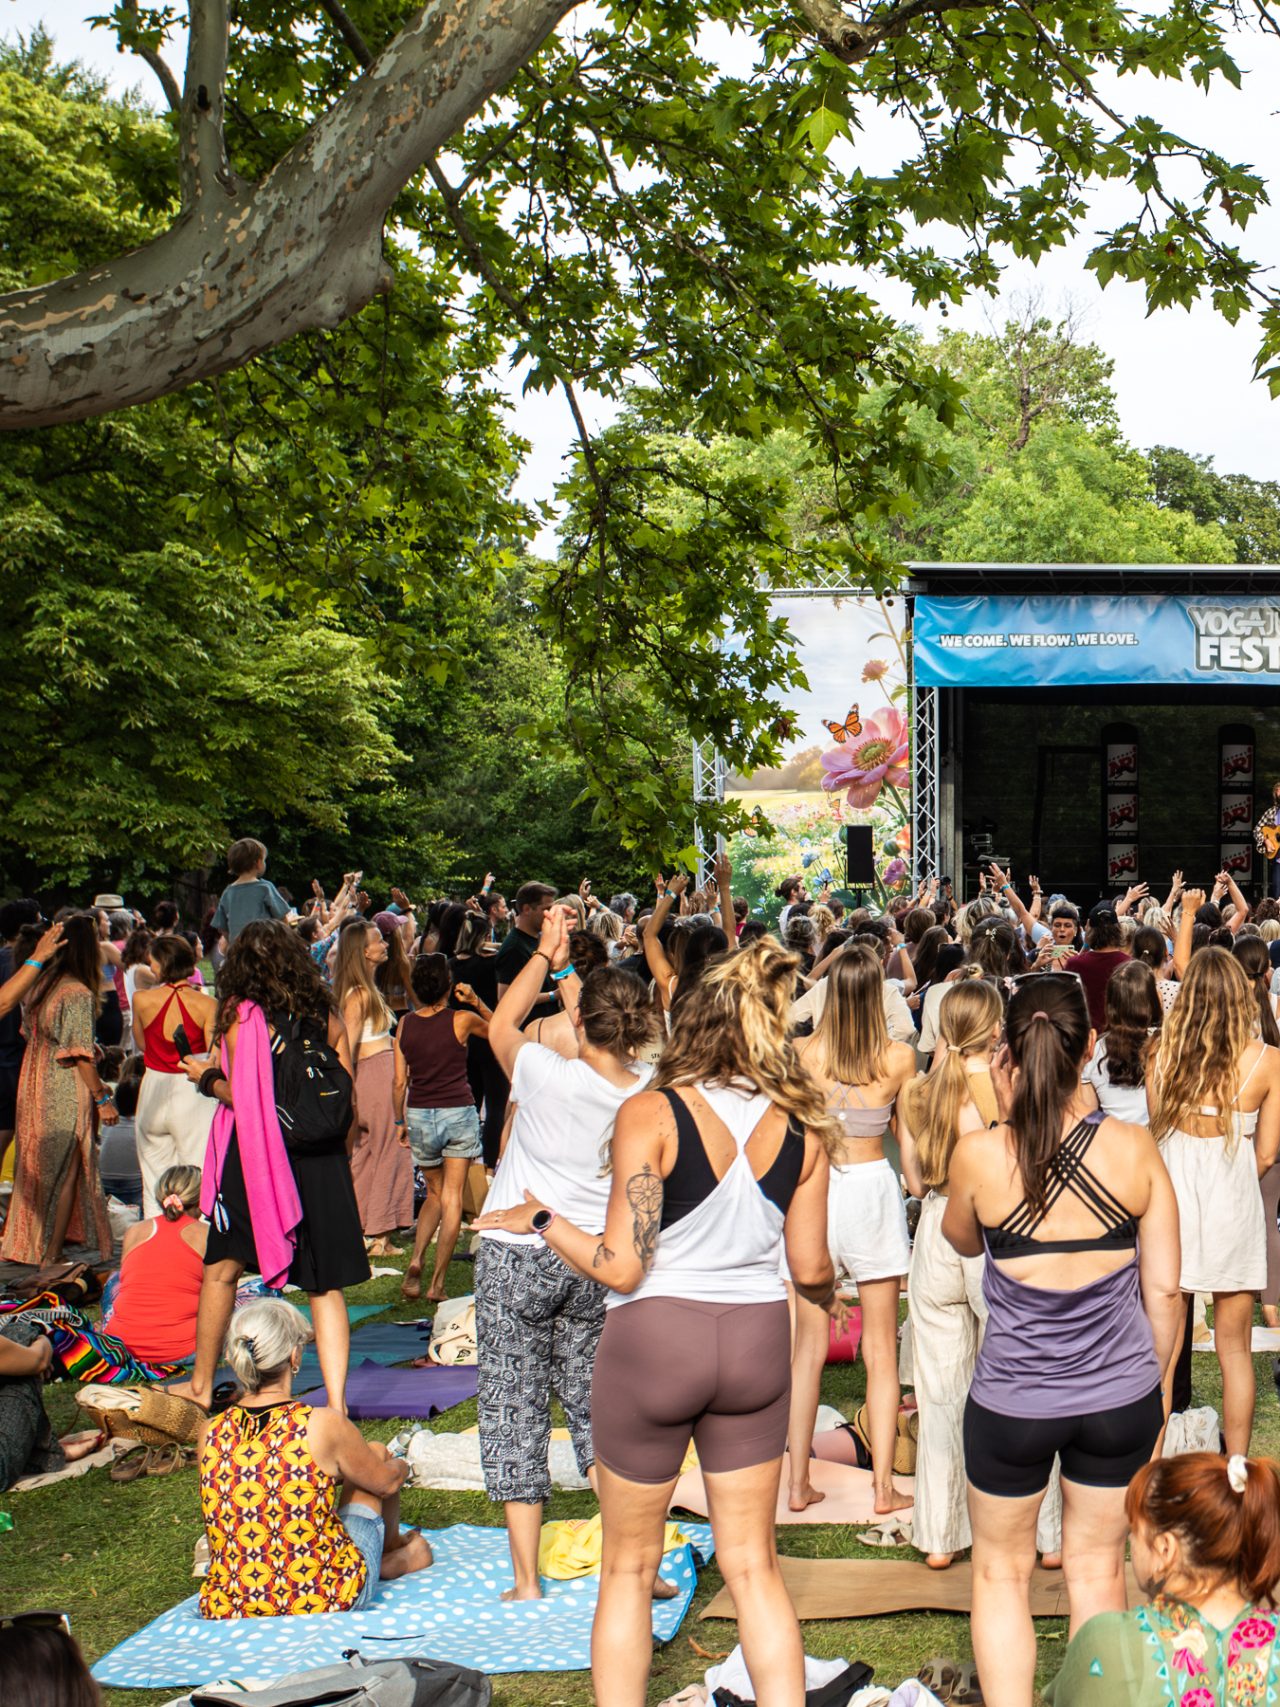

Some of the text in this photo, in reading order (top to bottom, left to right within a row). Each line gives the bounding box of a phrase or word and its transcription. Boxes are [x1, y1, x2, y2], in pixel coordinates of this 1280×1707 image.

[940, 633, 1138, 648] WE COME. WE FLOW. WE LOVE.
